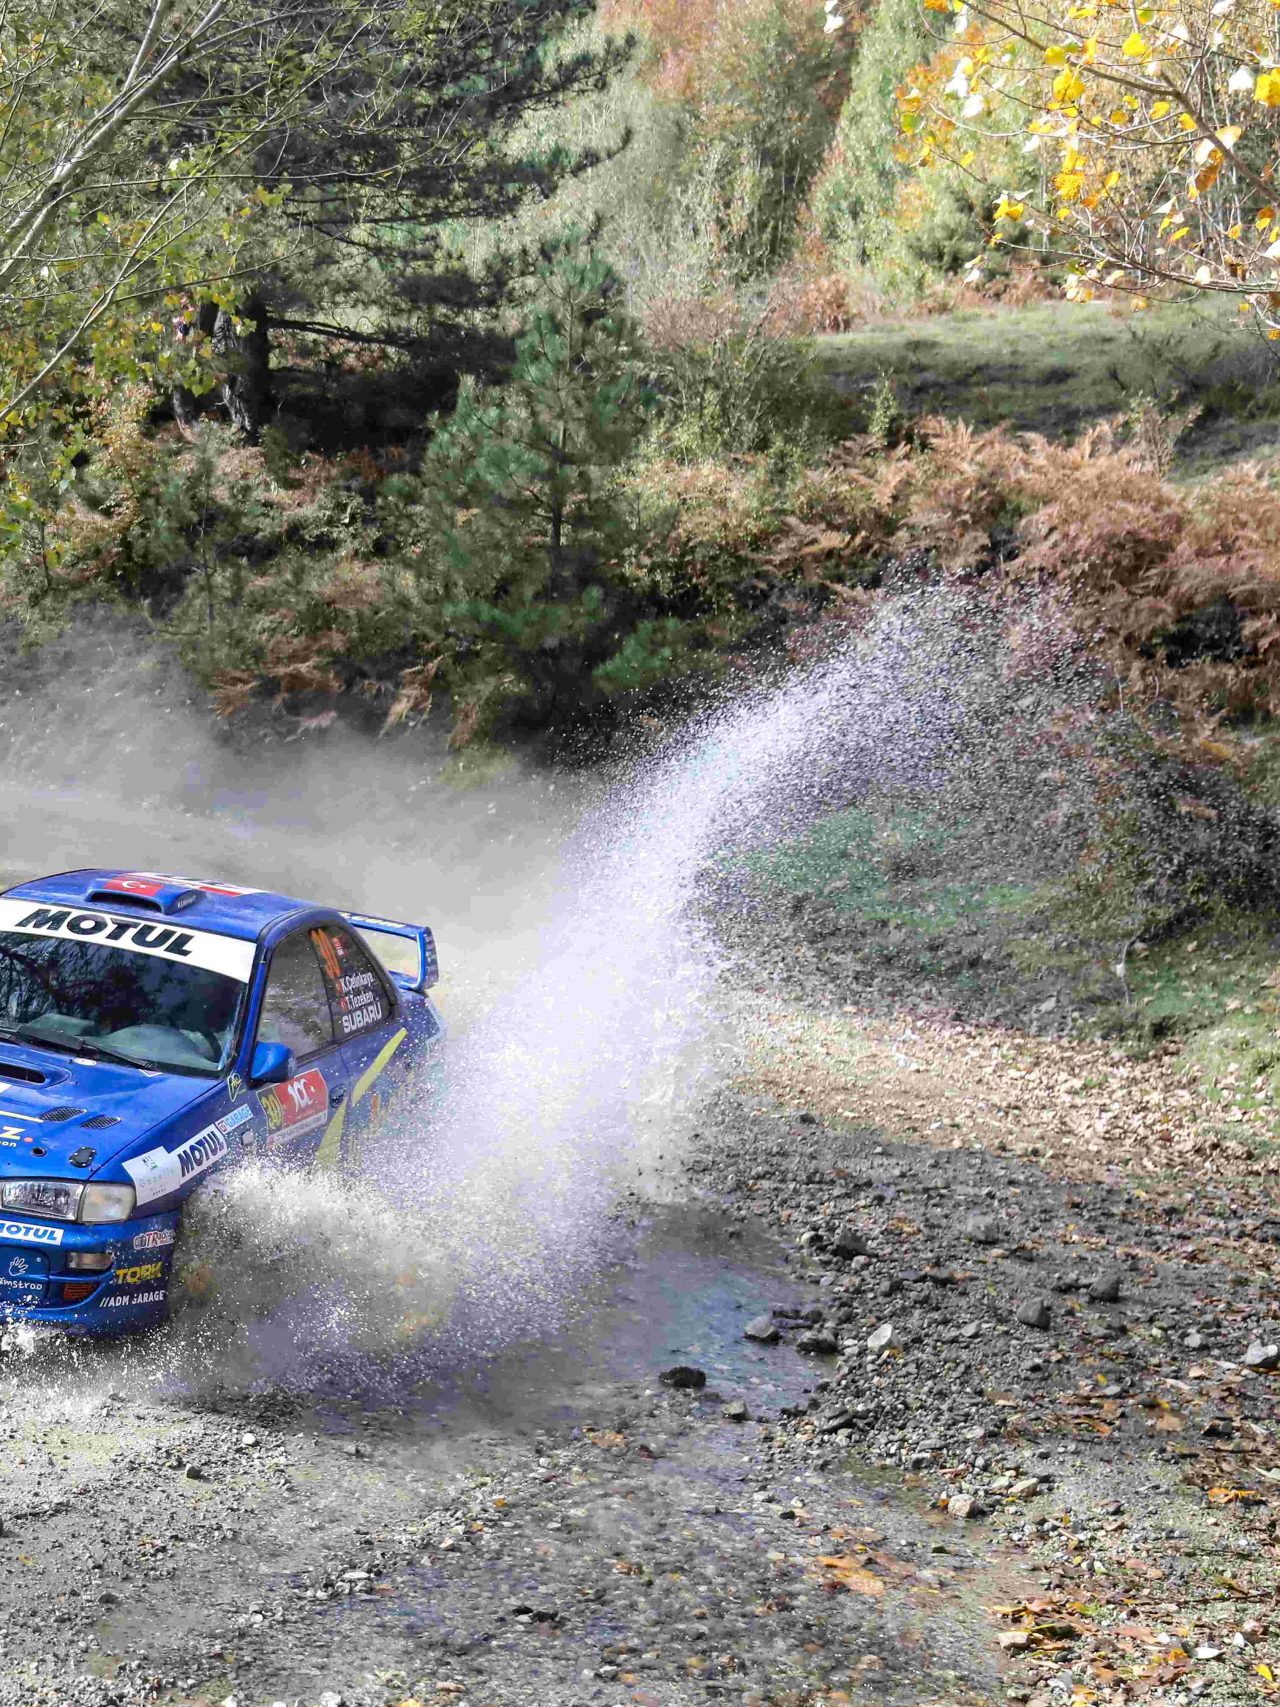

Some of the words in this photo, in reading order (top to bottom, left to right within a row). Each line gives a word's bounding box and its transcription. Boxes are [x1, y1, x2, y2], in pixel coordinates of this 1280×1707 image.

[14, 908, 195, 957] MOTUL
[342, 1002, 383, 1034] SUBARU
[177, 1130, 224, 1178] MOTUL
